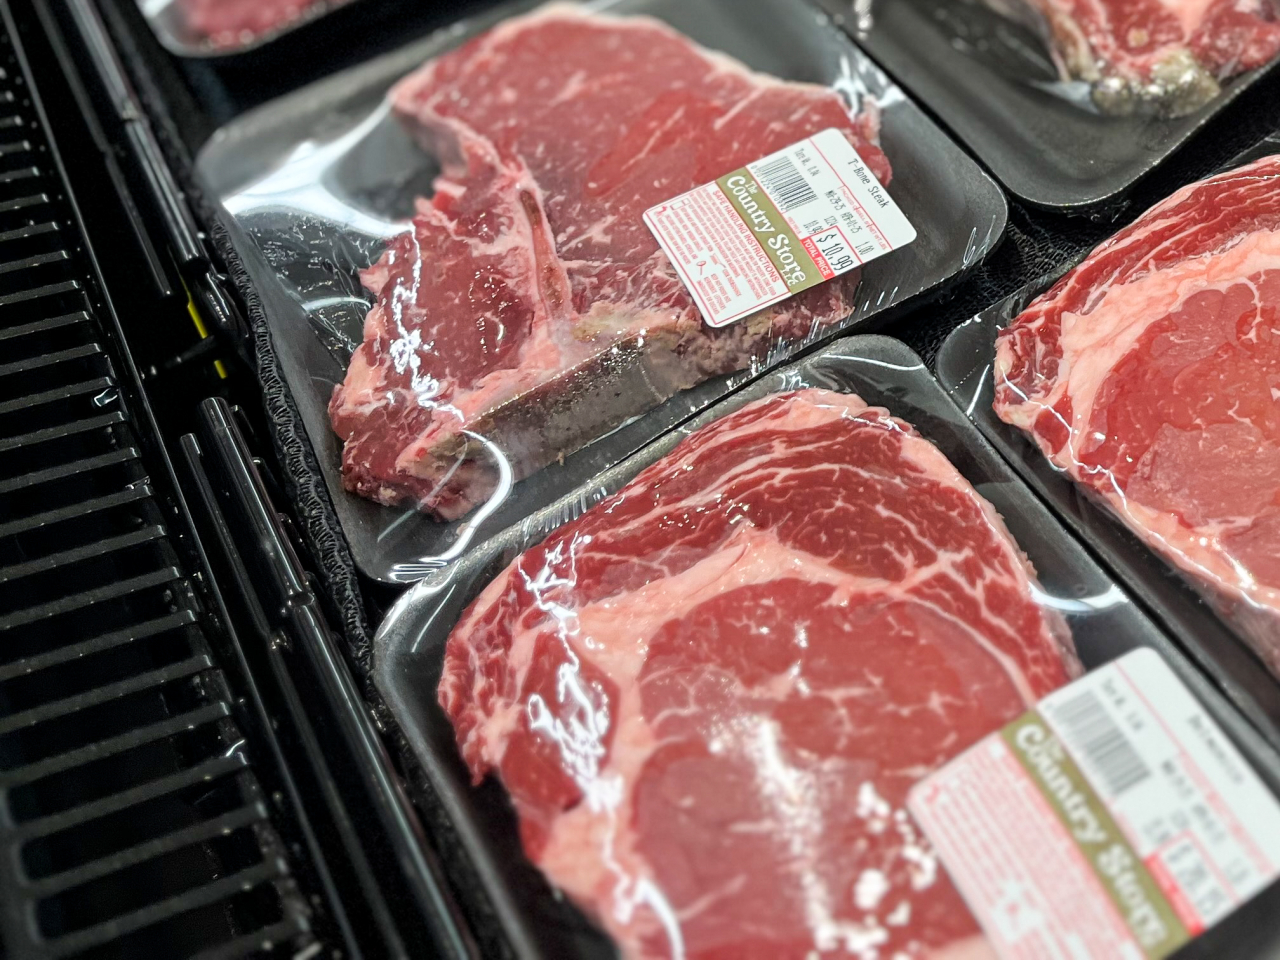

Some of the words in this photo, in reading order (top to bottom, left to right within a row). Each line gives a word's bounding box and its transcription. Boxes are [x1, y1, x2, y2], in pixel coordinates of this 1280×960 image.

[744, 180, 760, 194] The
[847, 158, 872, 185] T-Bone
[867, 185, 891, 208] Steak
[711, 189, 728, 205] SAFE
[722, 204, 748, 235] HANDLING
[742, 233, 780, 283] INSTRUCTIONS
[724, 174, 775, 236] Country
[765, 232, 813, 285] Store
[815, 231, 837, 244] $
[801, 239, 819, 257] TOTAL
[813, 256, 832, 275] PRICE
[820, 241, 855, 272] 10.99
[854, 240, 875, 256] 1.00
[778, 267, 797, 287] LLC
[1008, 719, 1109, 850] Country
[1094, 841, 1169, 949] Store
